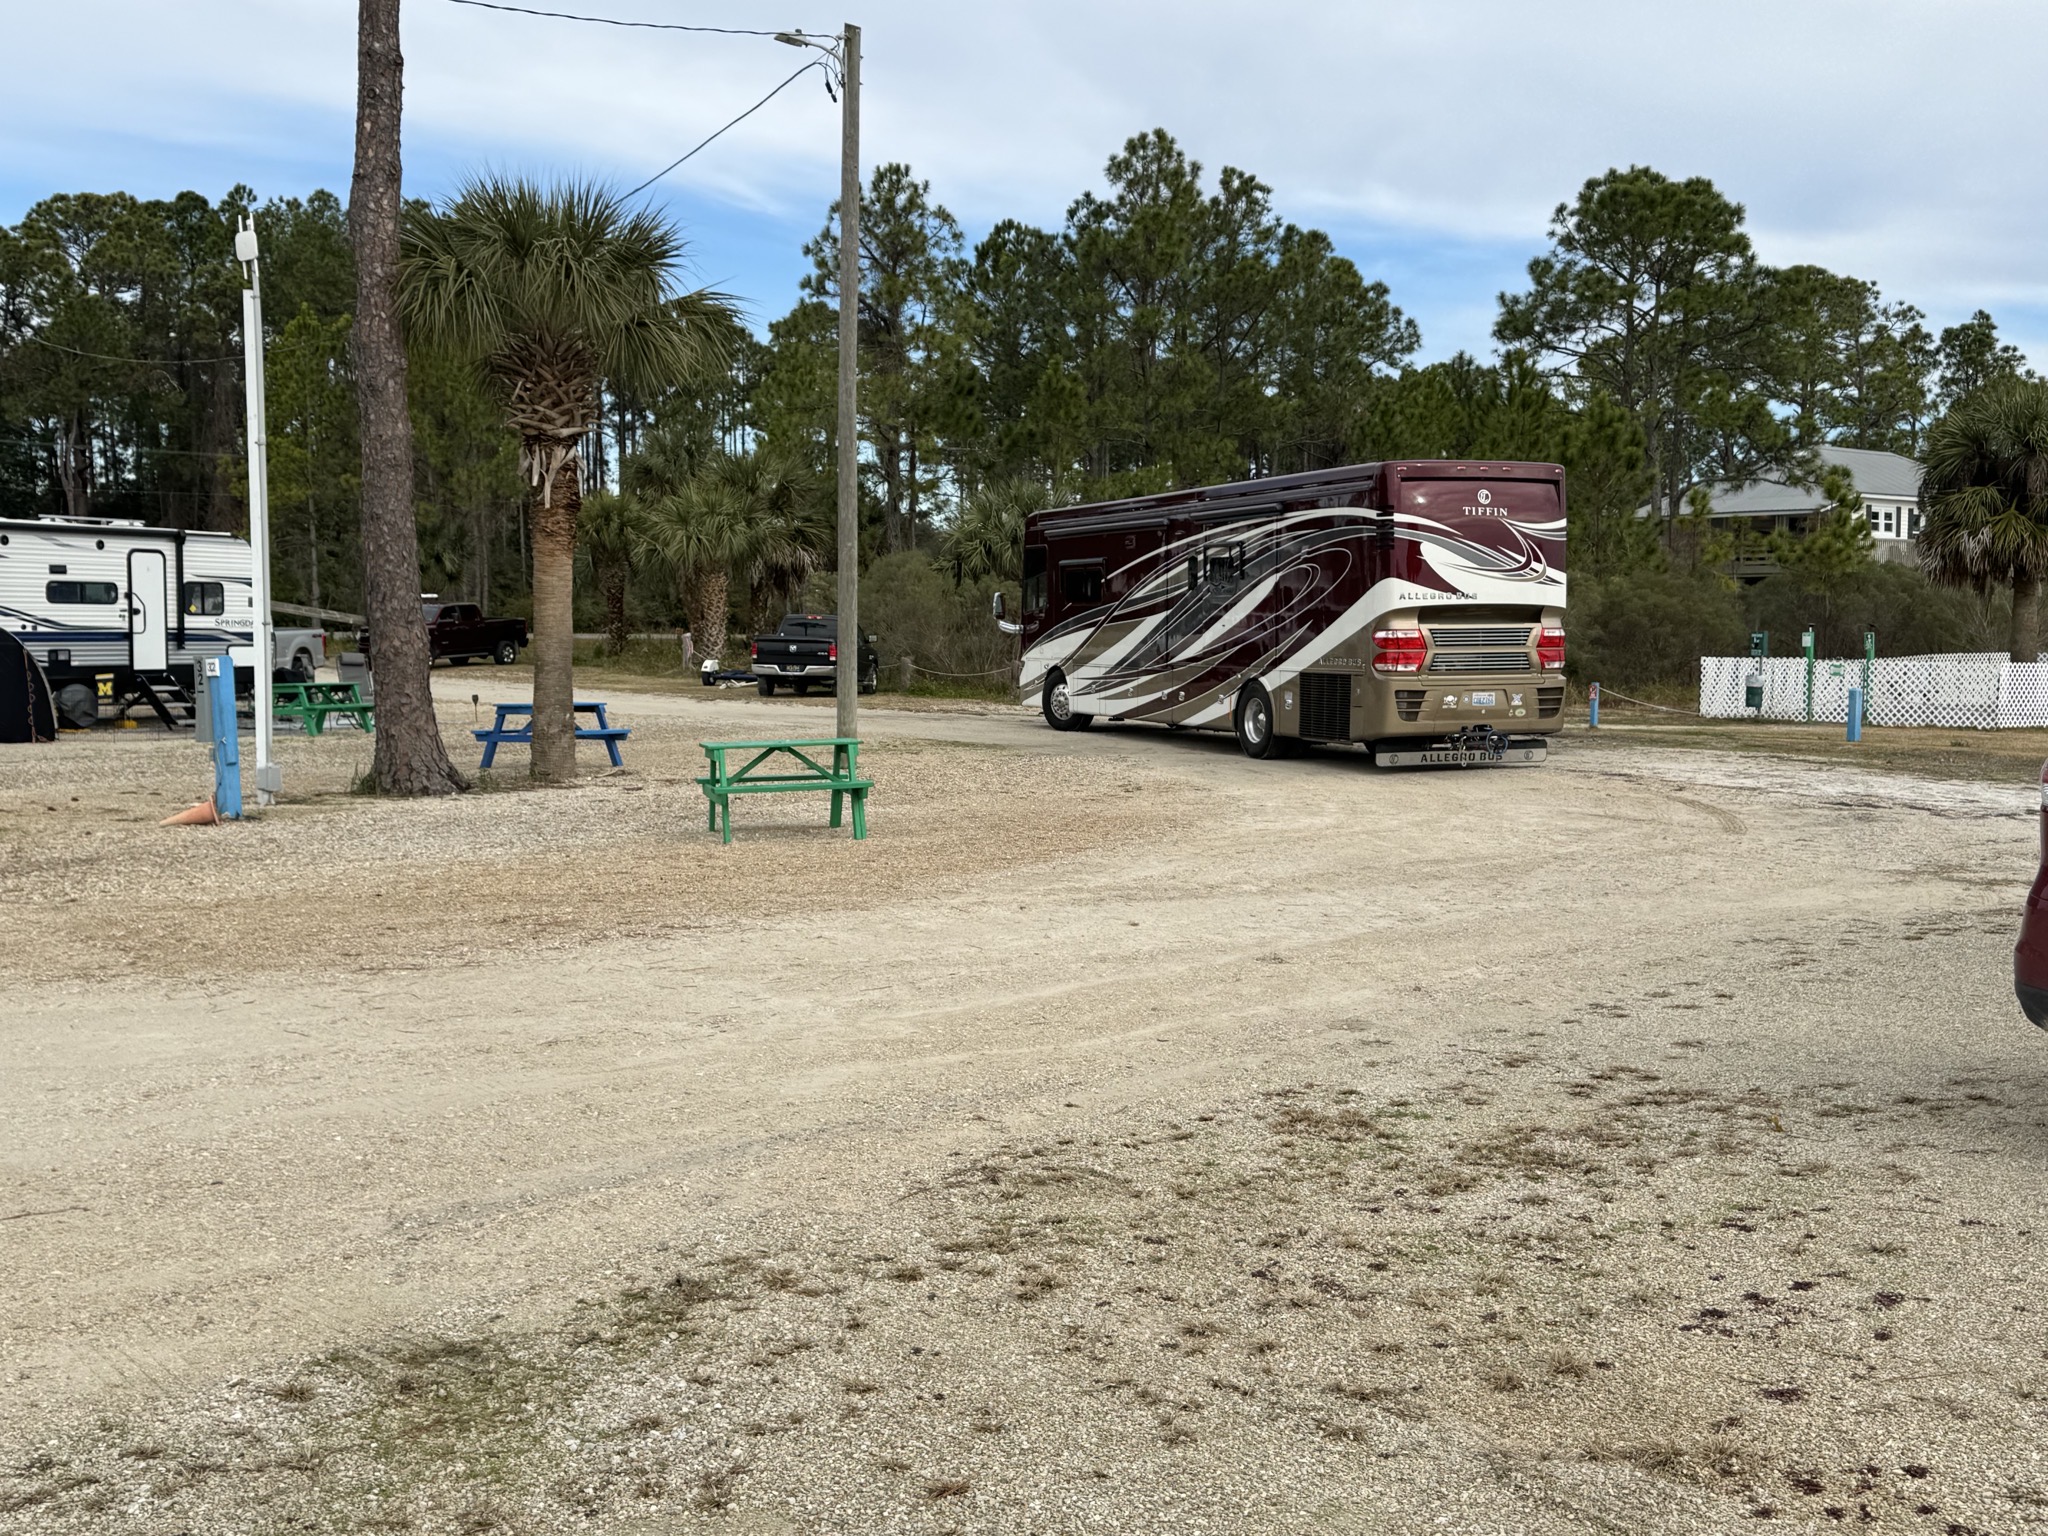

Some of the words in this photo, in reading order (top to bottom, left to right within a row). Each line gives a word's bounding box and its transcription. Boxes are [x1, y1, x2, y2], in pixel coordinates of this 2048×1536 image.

[1462, 506, 1508, 516] TIFFIN
[1398, 592, 1453, 600] ALLEGRO
[1455, 591, 1478, 600] BUS
[207, 662, 216, 672] 32
[97, 681, 113, 696] M
[1420, 751, 1476, 763] ALLEGRO
